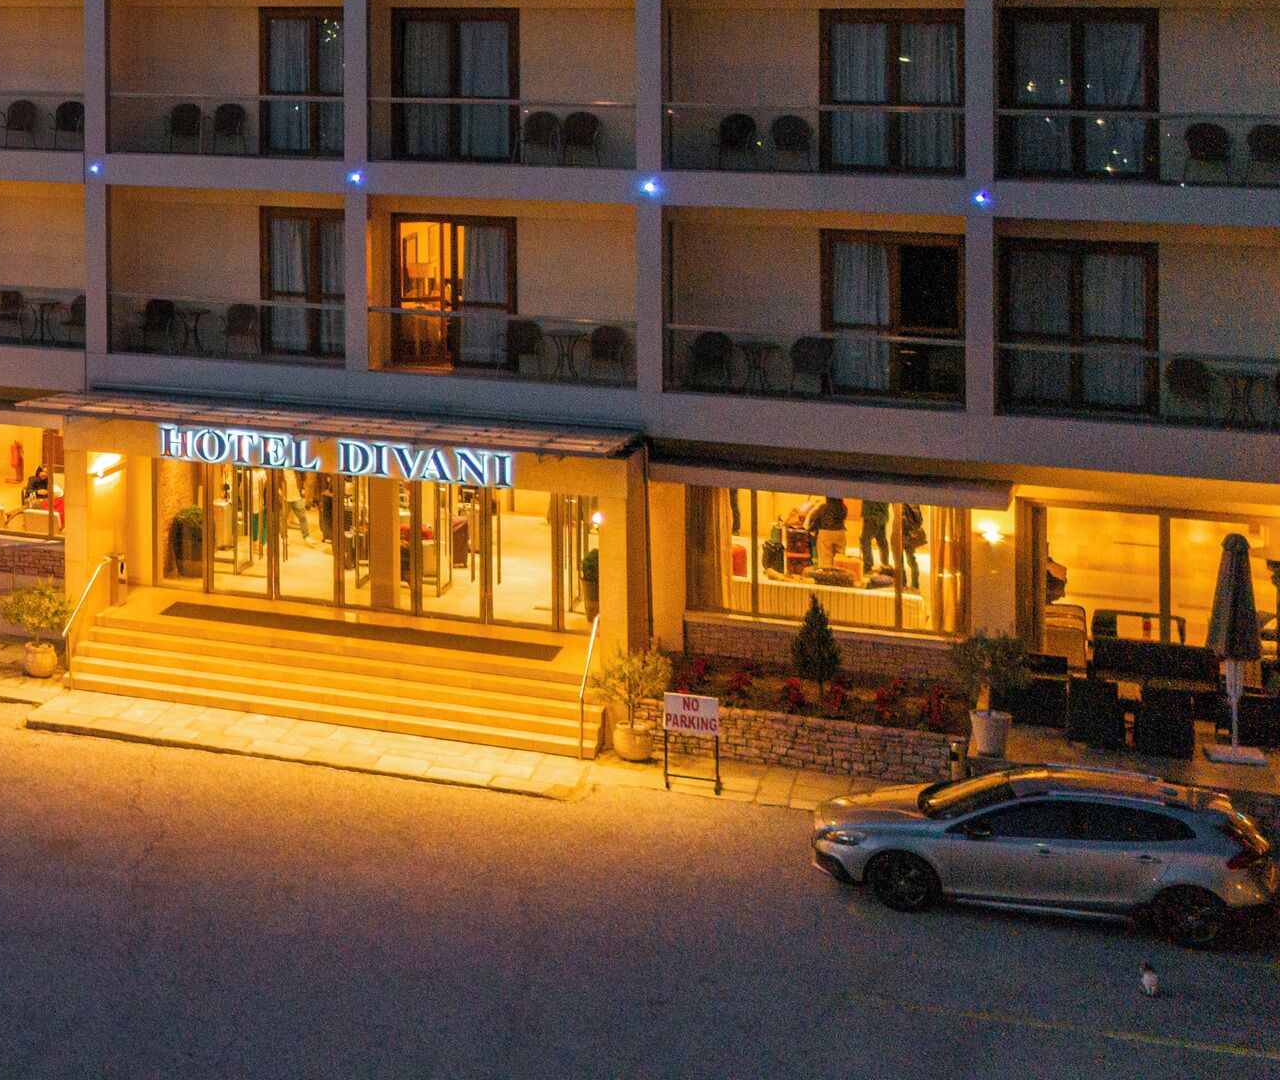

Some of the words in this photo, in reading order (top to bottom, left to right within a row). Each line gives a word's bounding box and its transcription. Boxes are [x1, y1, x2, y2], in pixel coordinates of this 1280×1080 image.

[159, 424, 321, 470] HOTEL
[338, 439, 513, 488] DIVANI
[683, 697, 699, 712] NO
[665, 713, 717, 732] PARKING
